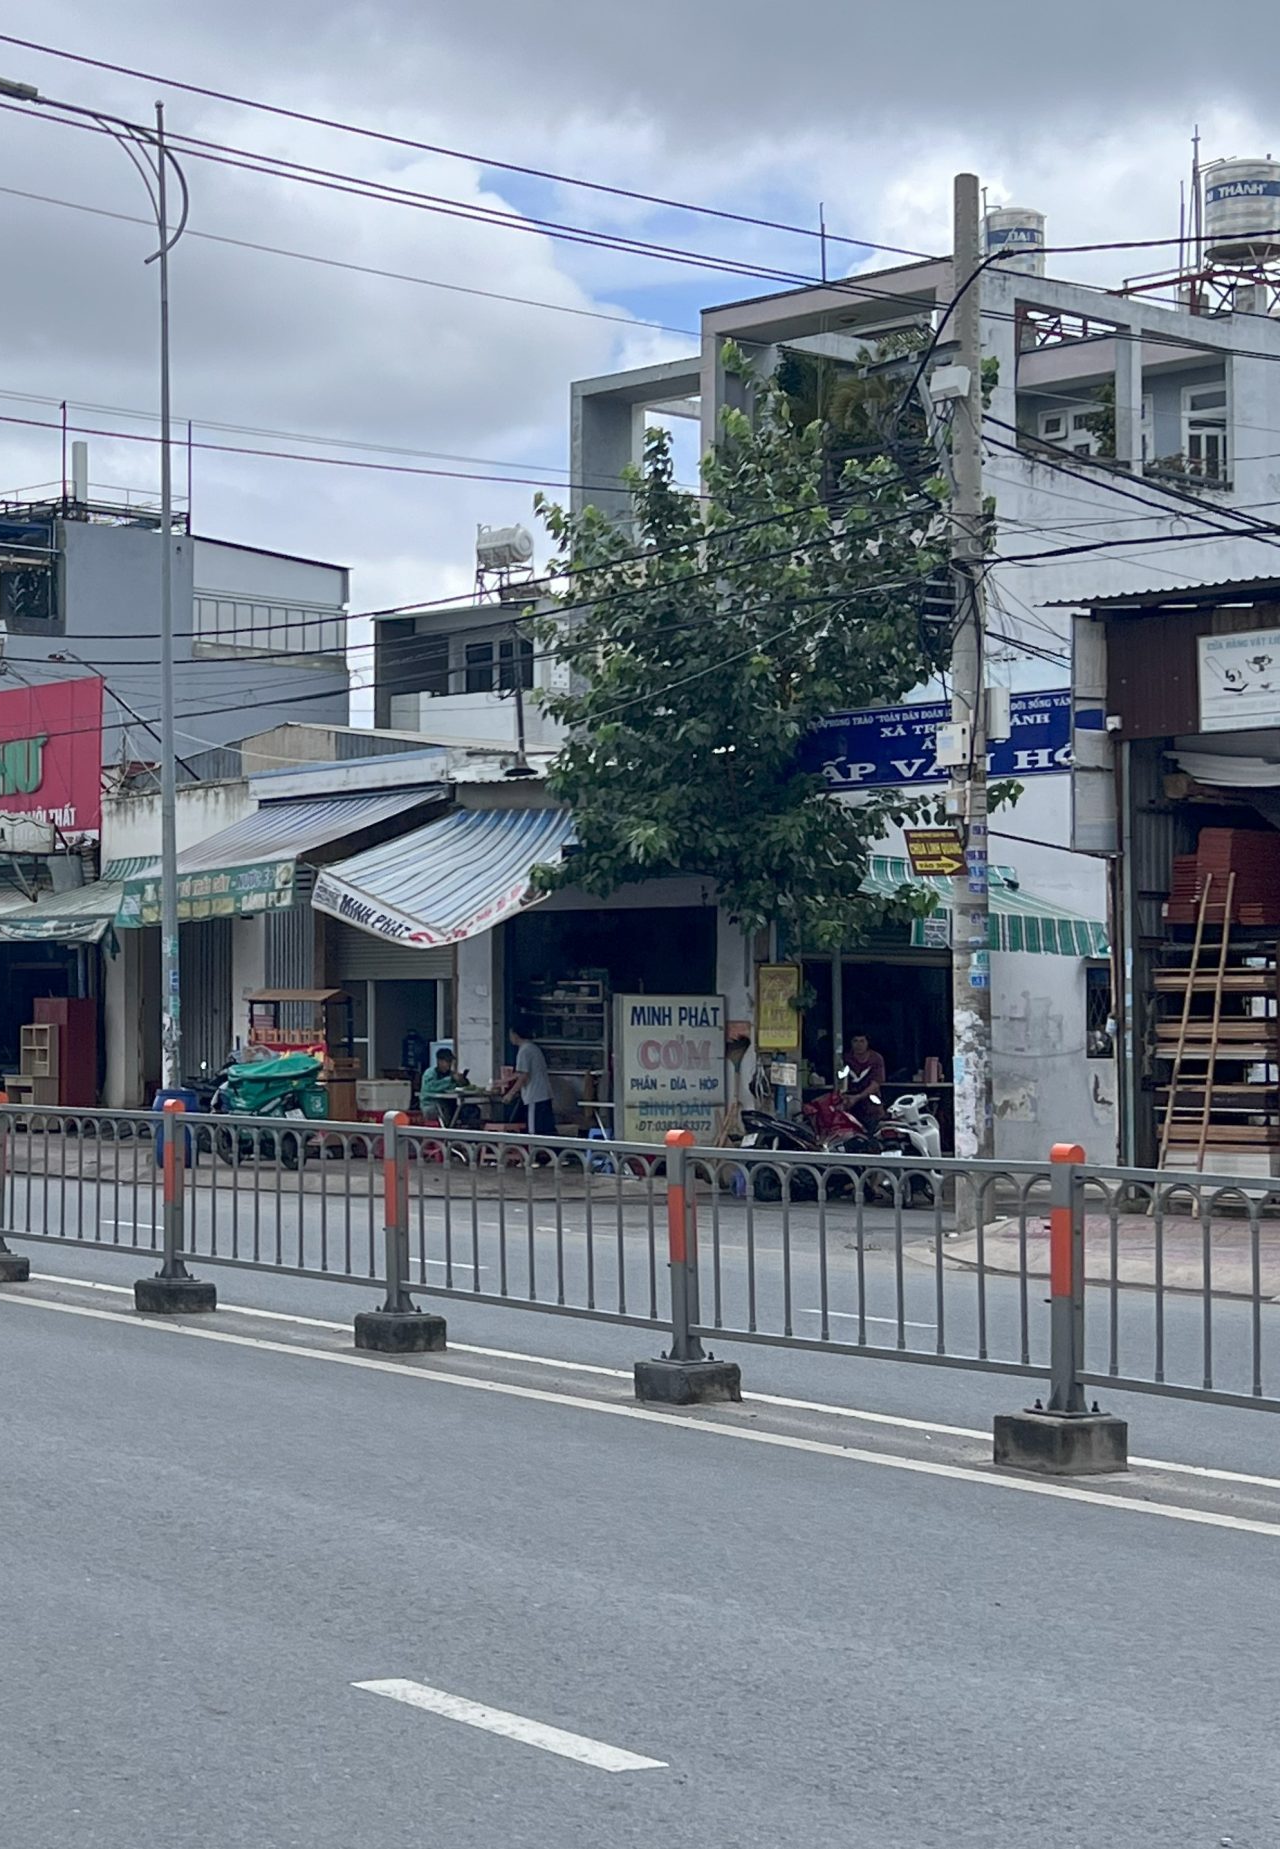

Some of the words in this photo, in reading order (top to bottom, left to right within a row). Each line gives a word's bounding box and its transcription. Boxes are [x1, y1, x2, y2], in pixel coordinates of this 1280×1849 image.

[880, 724, 907, 738] XÃ
[822, 756, 877, 784] ẤP
[338, 892, 371, 926] MINH
[630, 1005, 673, 1027] MINH
[678, 1001, 720, 1027] PHÁT
[637, 1034, 712, 1071] CƠM
